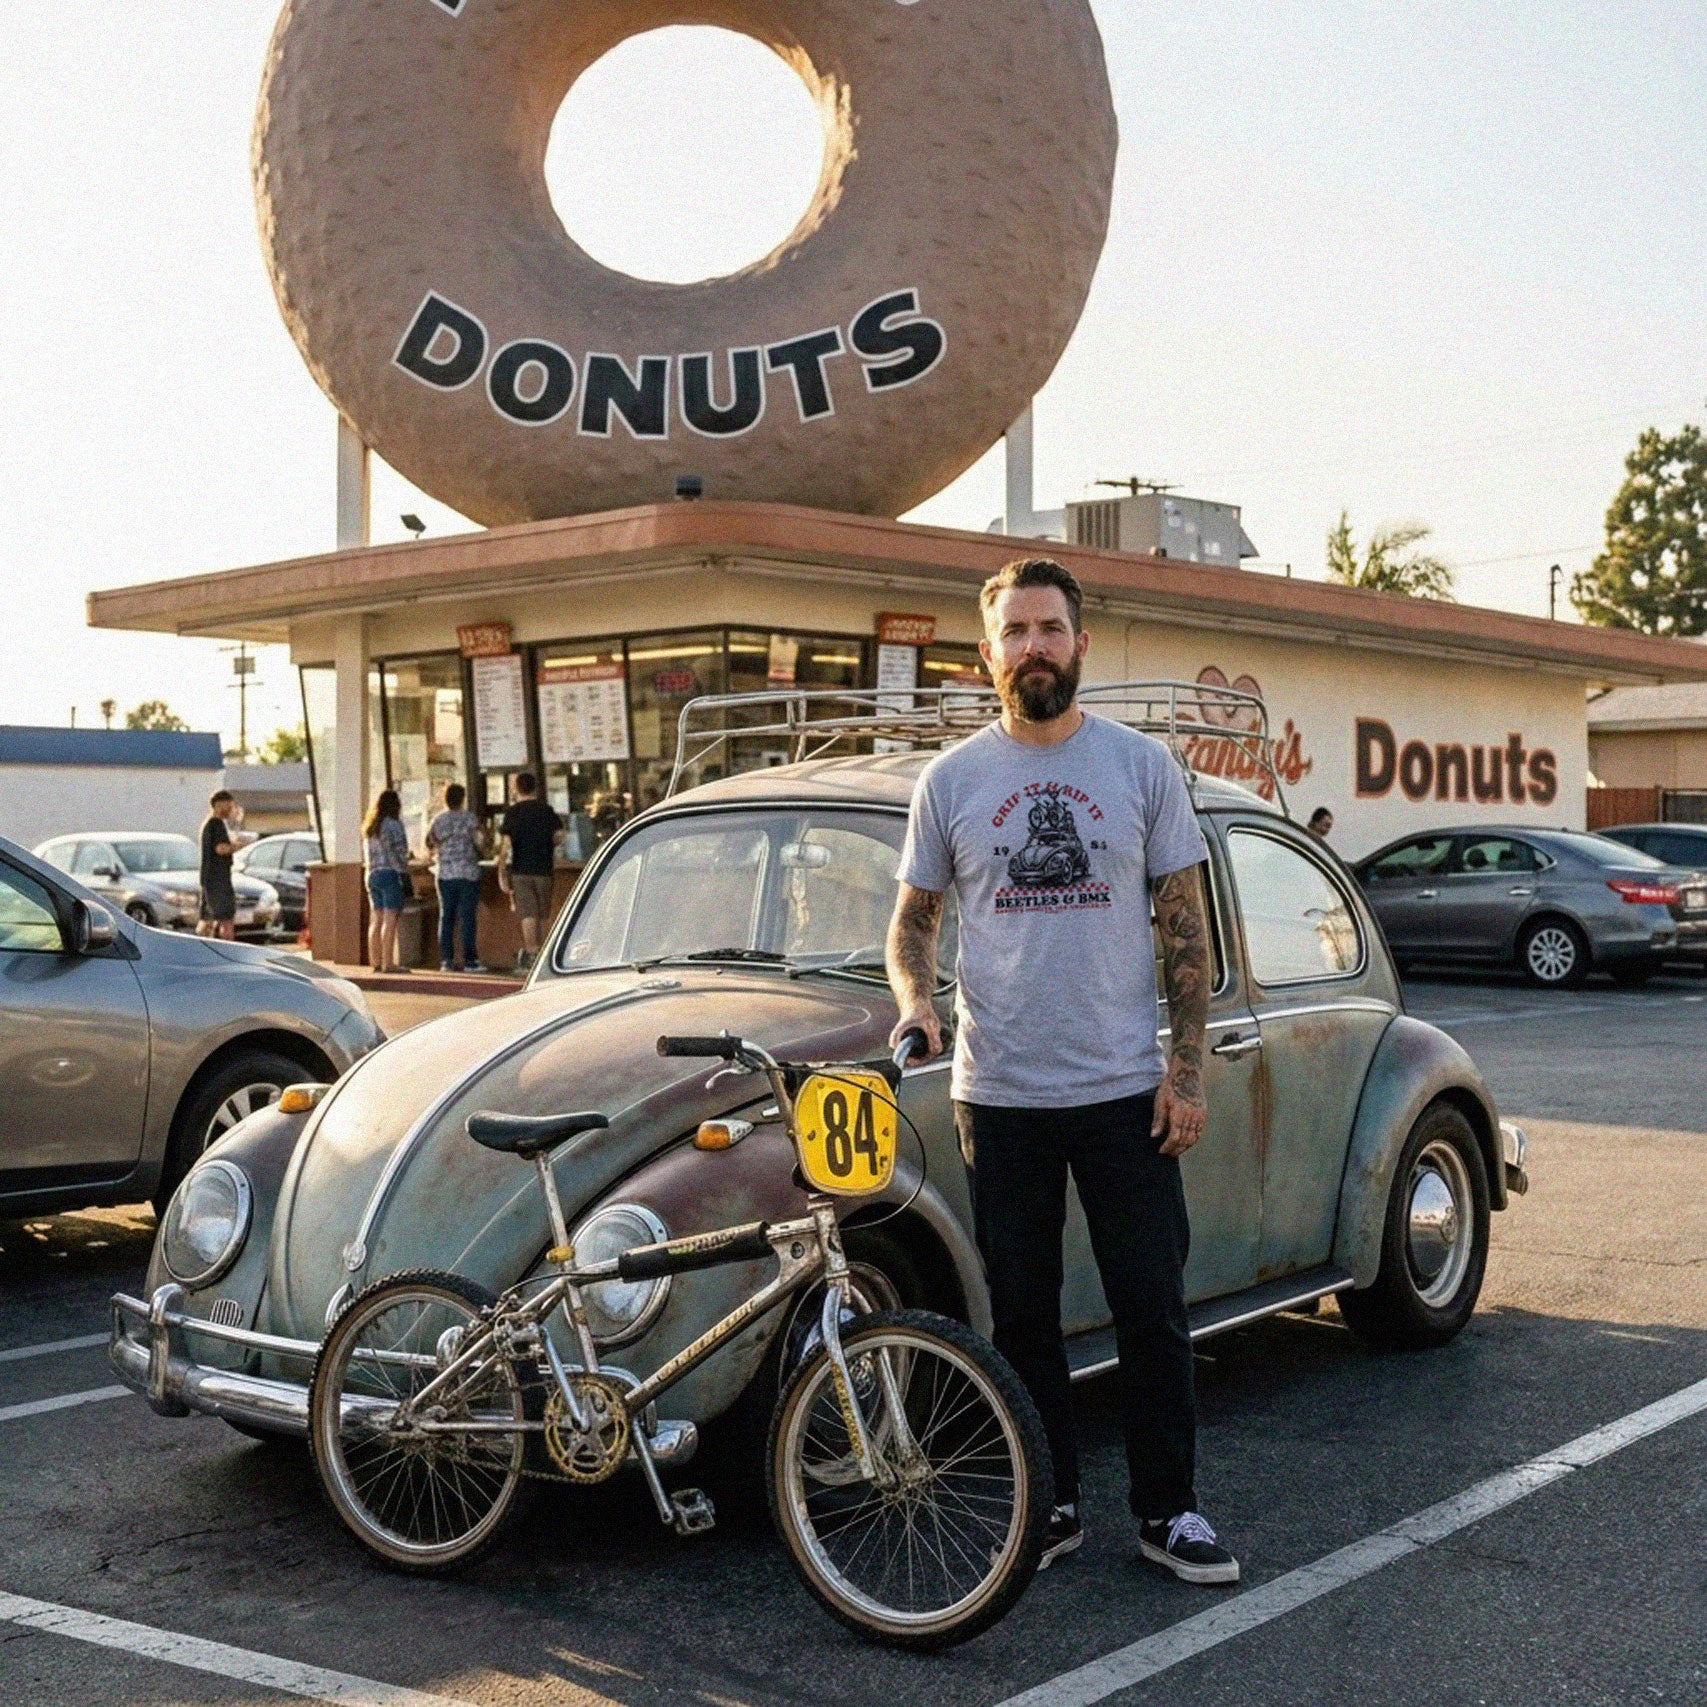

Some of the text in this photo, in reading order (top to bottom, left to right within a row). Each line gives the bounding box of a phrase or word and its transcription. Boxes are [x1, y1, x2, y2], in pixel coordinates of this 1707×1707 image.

[391, 286, 947, 440] DONUTS
[1023, 782, 1041, 798] IT
[1062, 784, 1089, 803] RIP
[1088, 803, 1104, 820] IT
[1354, 715, 1559, 808] Donuts
[995, 892, 1110, 908] BEETLES & BMX
[823, 1089, 879, 1178] 84
